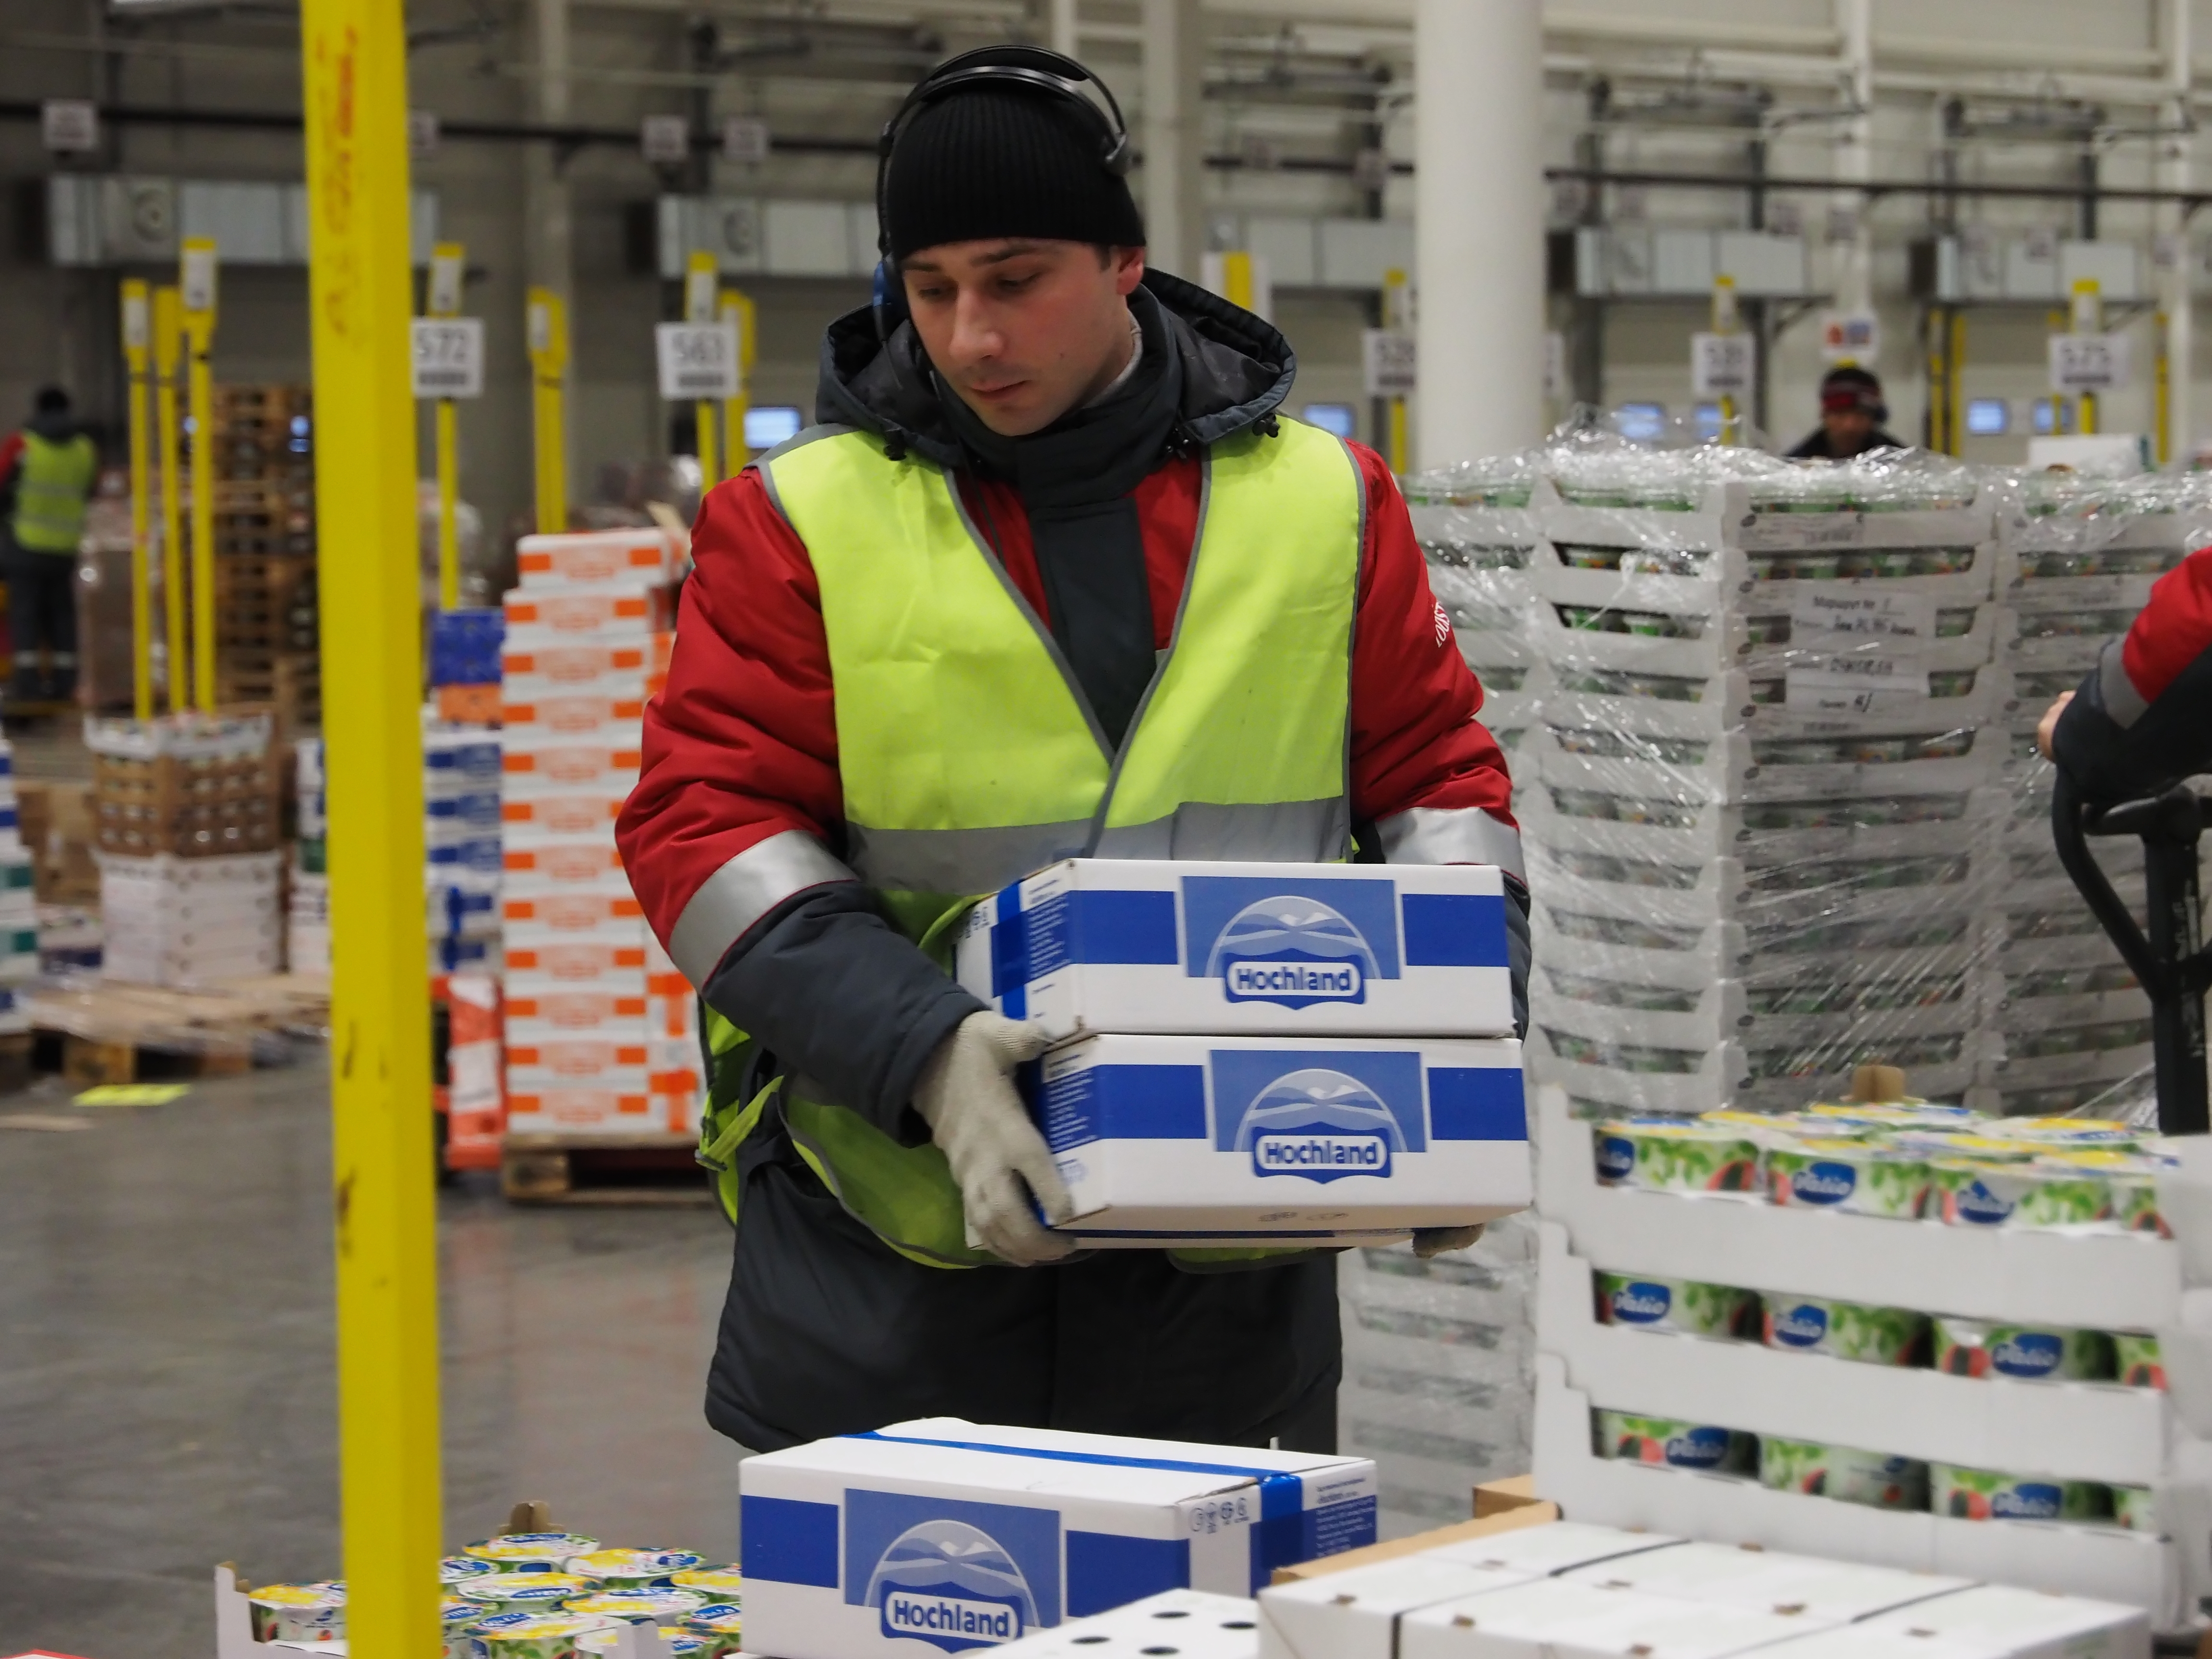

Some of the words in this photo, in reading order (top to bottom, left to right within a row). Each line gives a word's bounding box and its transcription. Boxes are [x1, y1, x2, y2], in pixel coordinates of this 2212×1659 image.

[1235, 966, 1351, 991] Hochland
[1264, 1140, 1378, 1165] Hochland
[1794, 1171, 1850, 1195] Valio
[1614, 1292, 1667, 1315] Valio
[1996, 1343, 2056, 1366] Valio
[893, 1599, 1009, 1637] Hochland
